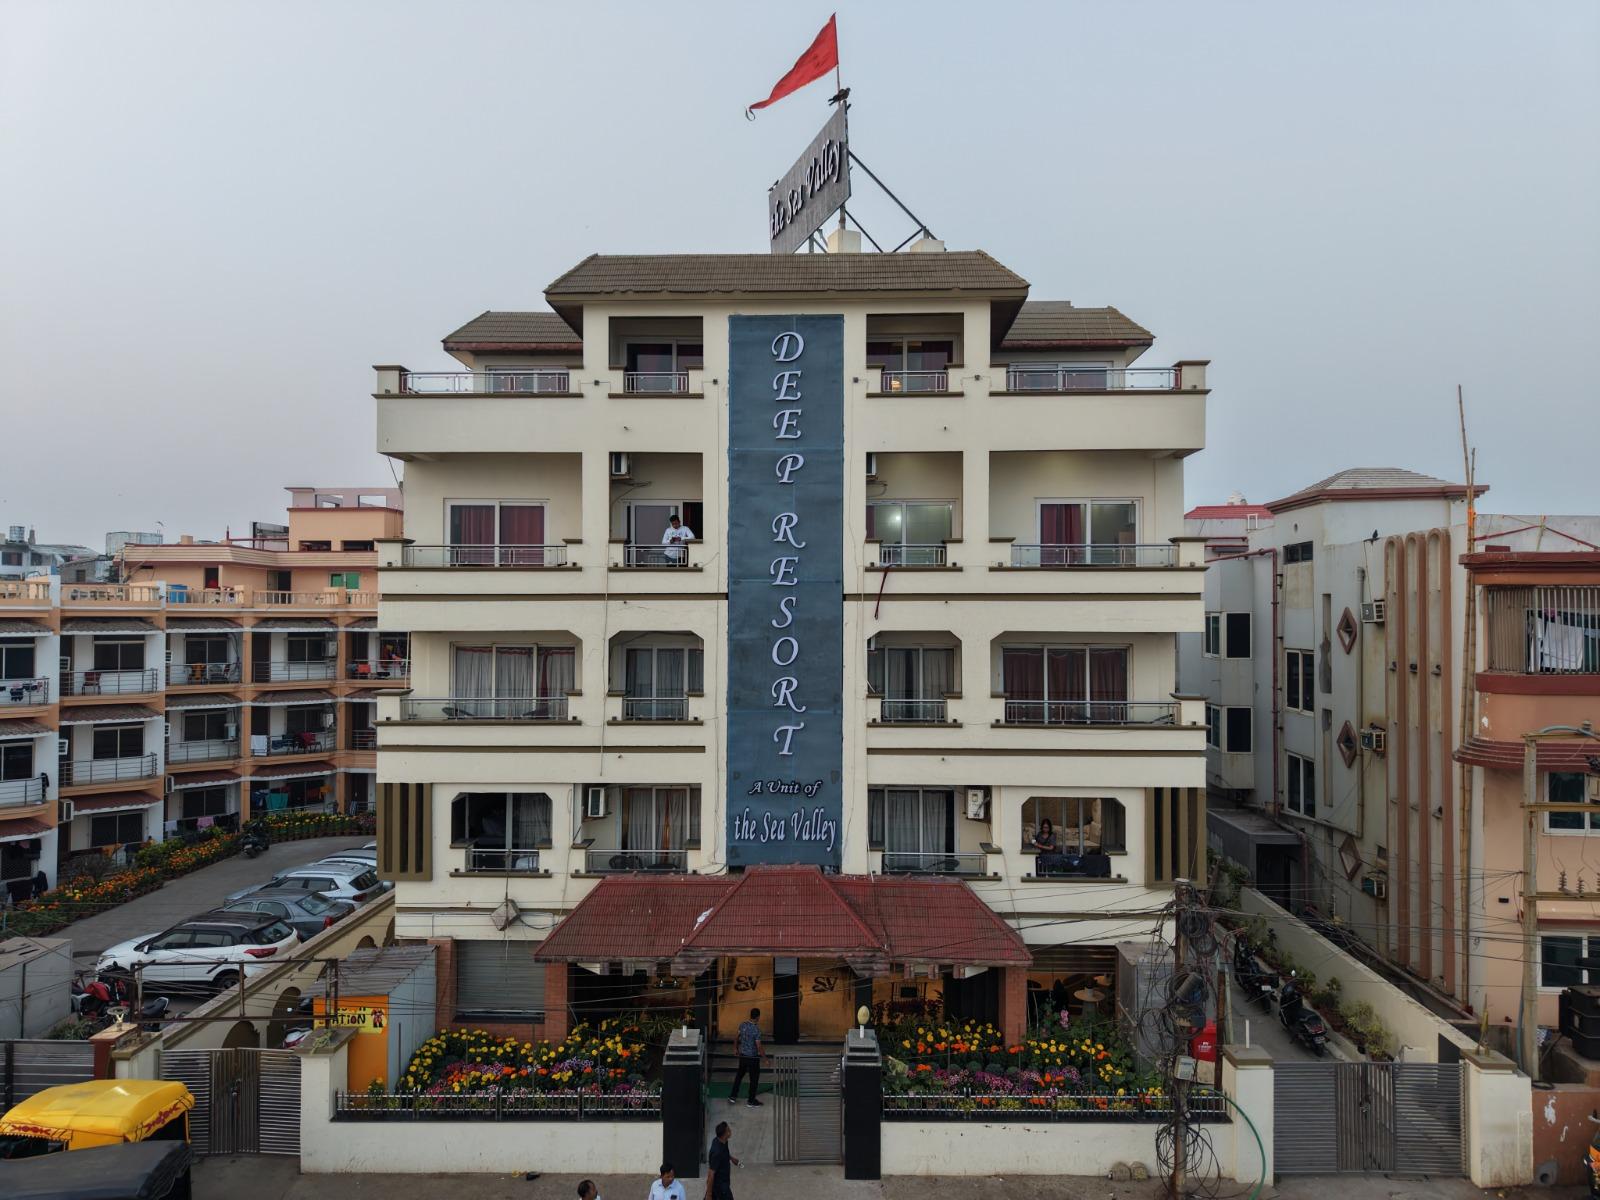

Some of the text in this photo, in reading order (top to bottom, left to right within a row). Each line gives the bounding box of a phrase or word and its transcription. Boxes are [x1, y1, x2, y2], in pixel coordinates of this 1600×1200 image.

[770, 139, 842, 240] the Sea Valley
[770, 331, 807, 756] DEEP RESORT
[748, 780, 822, 797] A Unit of
[735, 807, 837, 852] the Sea Valley
